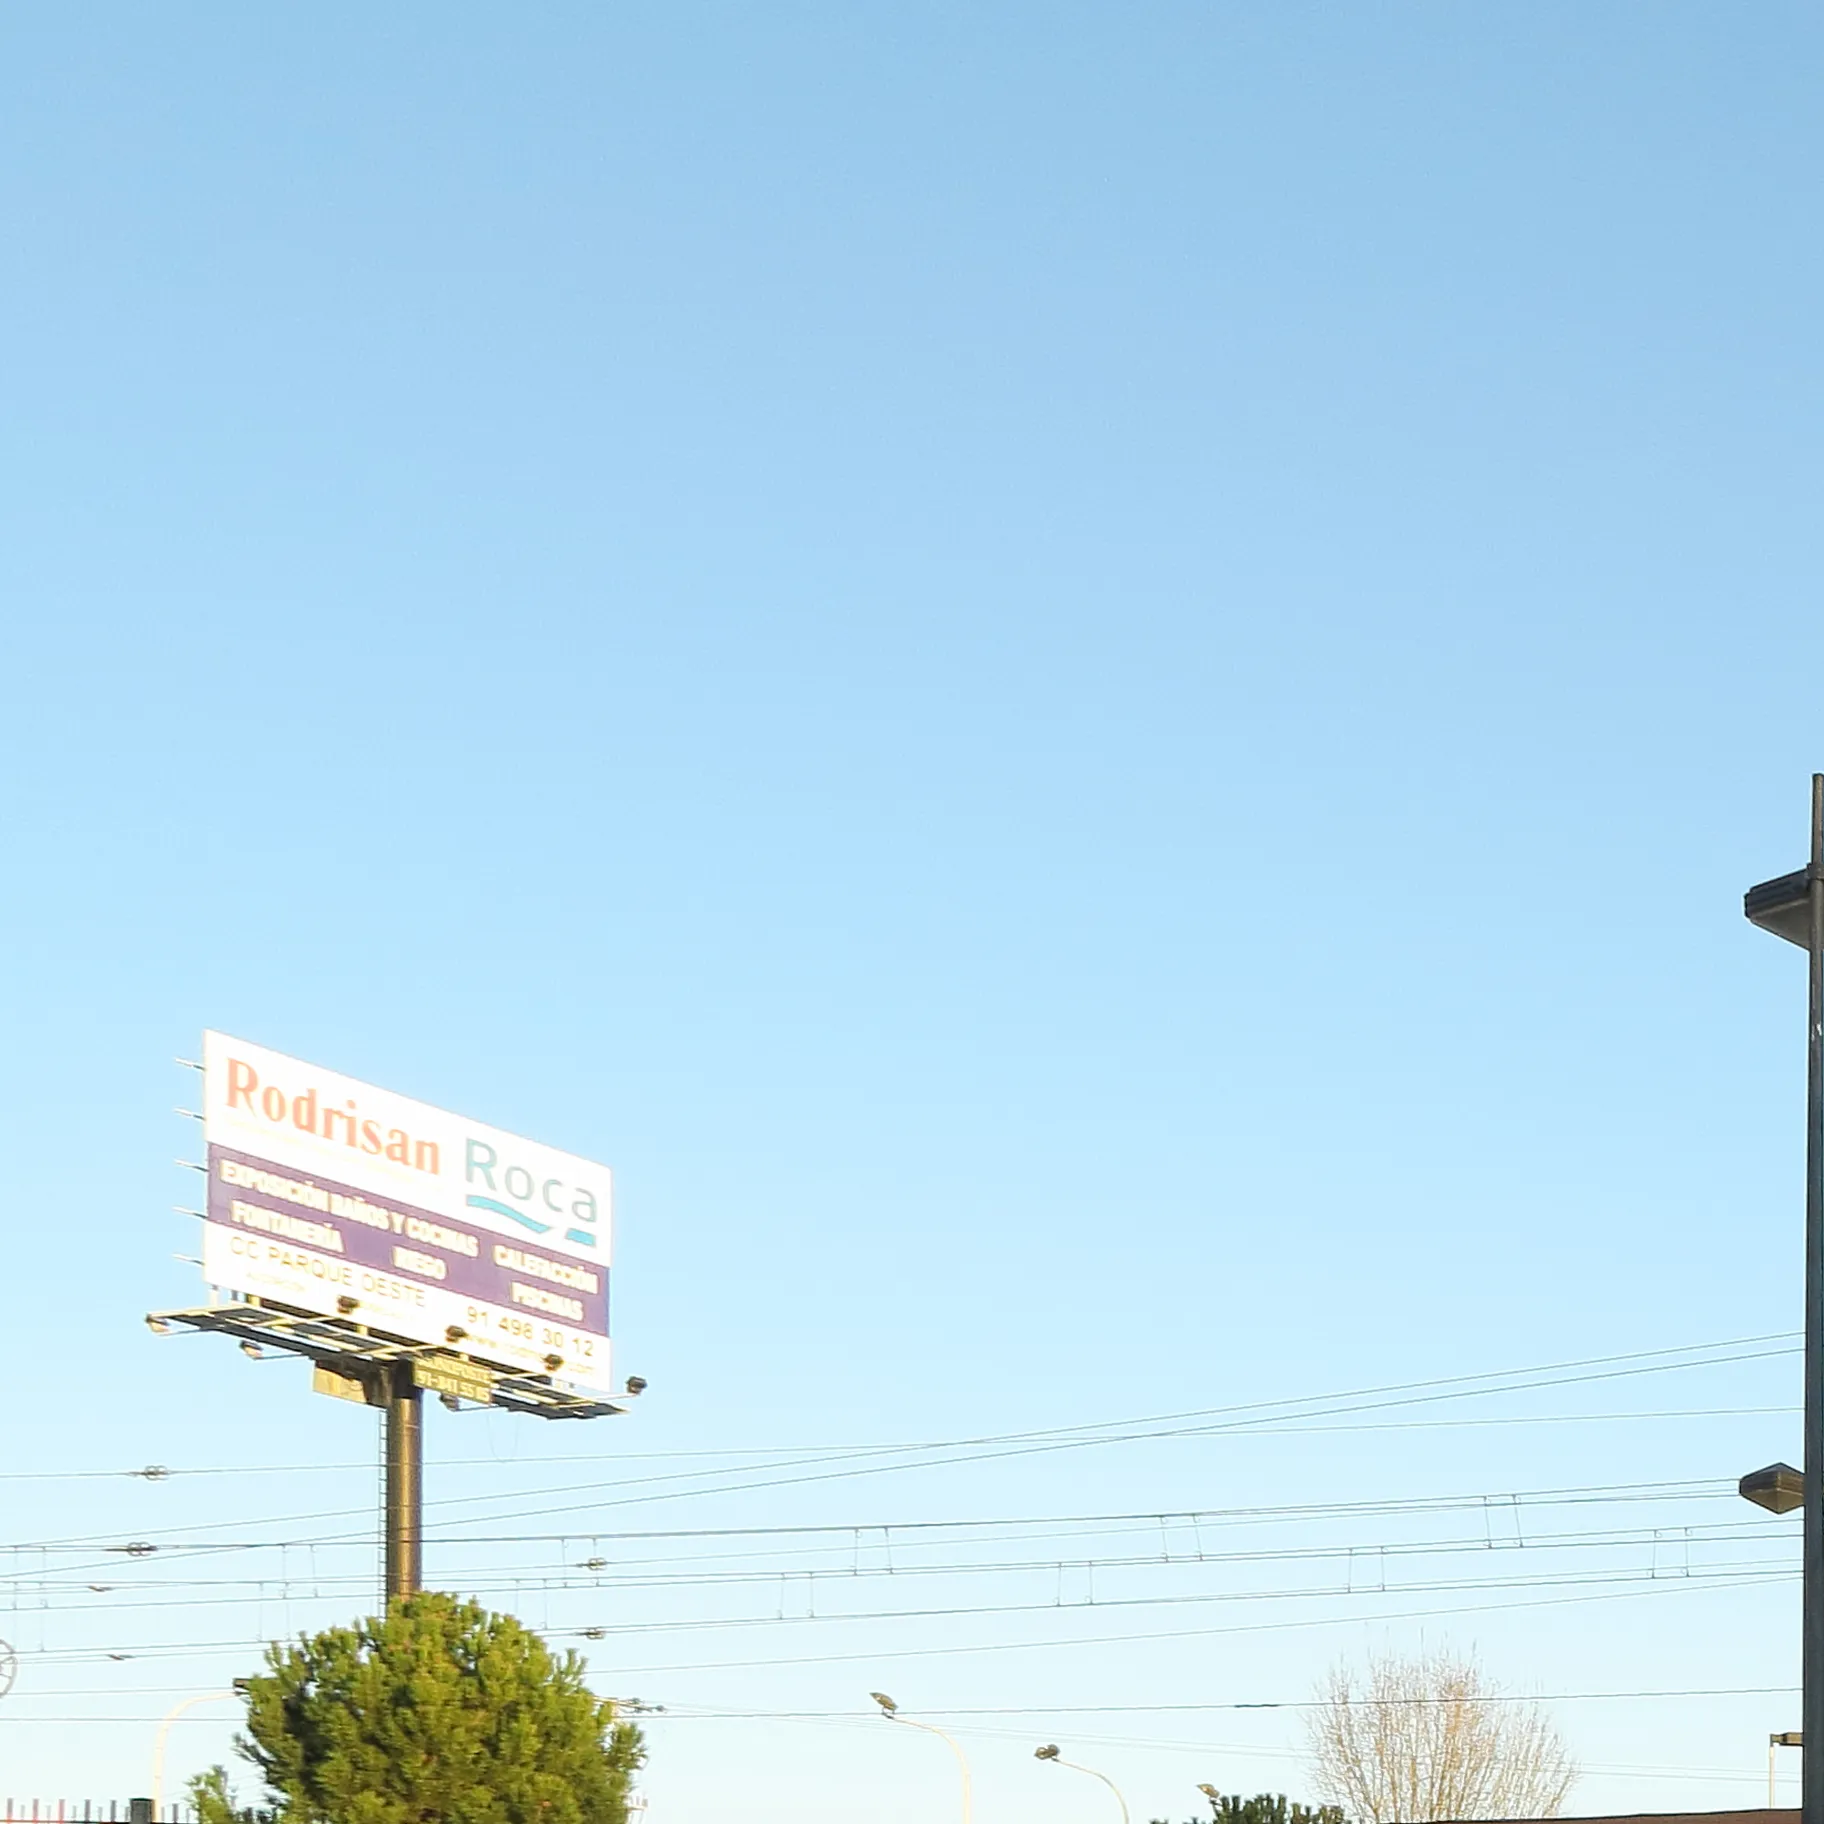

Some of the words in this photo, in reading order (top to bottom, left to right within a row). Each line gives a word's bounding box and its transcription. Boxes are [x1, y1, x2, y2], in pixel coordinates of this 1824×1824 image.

[226, 1057, 440, 1177] Rodrisan
[464, 1137, 598, 1223] Roca
[231, 1237, 260, 1260] CC
[268, 1247, 353, 1287] PARQUE
[362, 1273, 425, 1308] OESTE
[467, 1306, 488, 1327] 91
[498, 1317, 534, 1340] 498
[543, 1328, 564, 1349] 30
[573, 1337, 594, 1357] 12
